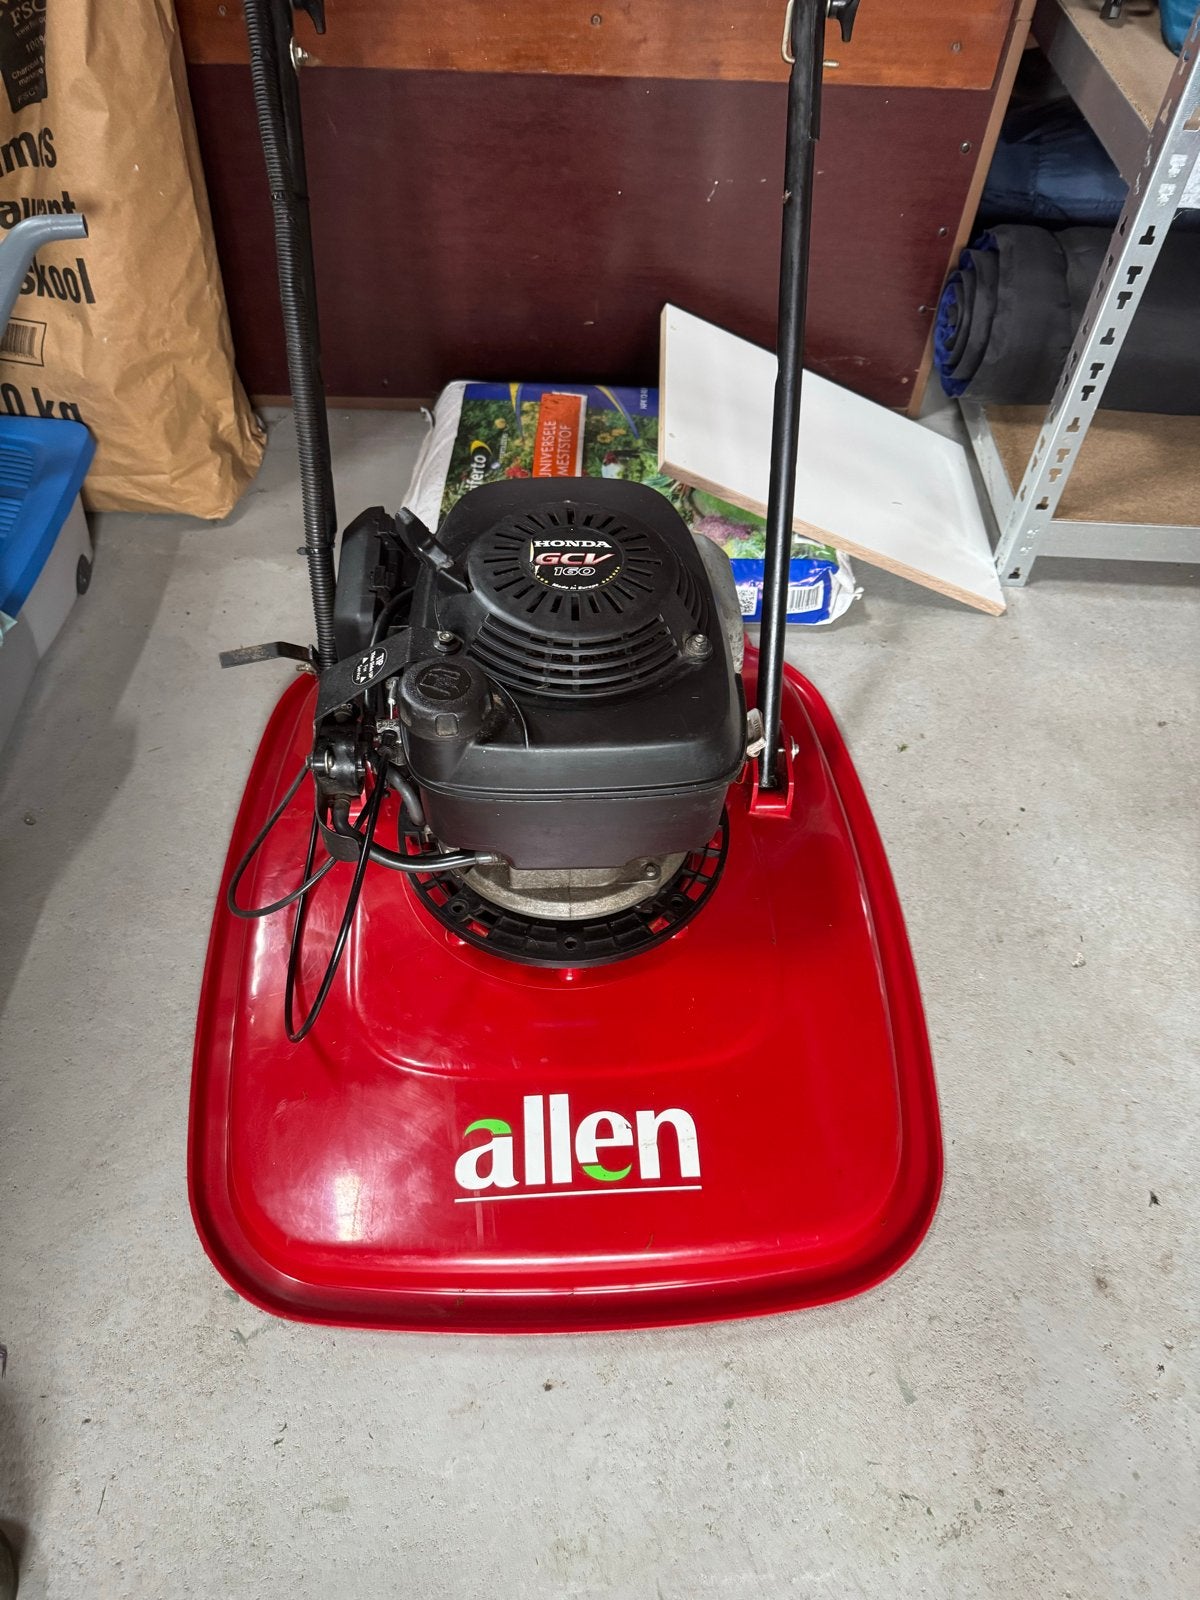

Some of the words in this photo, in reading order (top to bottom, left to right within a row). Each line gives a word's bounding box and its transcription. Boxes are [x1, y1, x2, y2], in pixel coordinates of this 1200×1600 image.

[556, 424, 572, 476] MESTSTOF
[533, 540, 612, 549] HONDA
[535, 552, 616, 566] GCV
[554, 567, 596, 577] 160
[454, 1093, 701, 1190] allen
